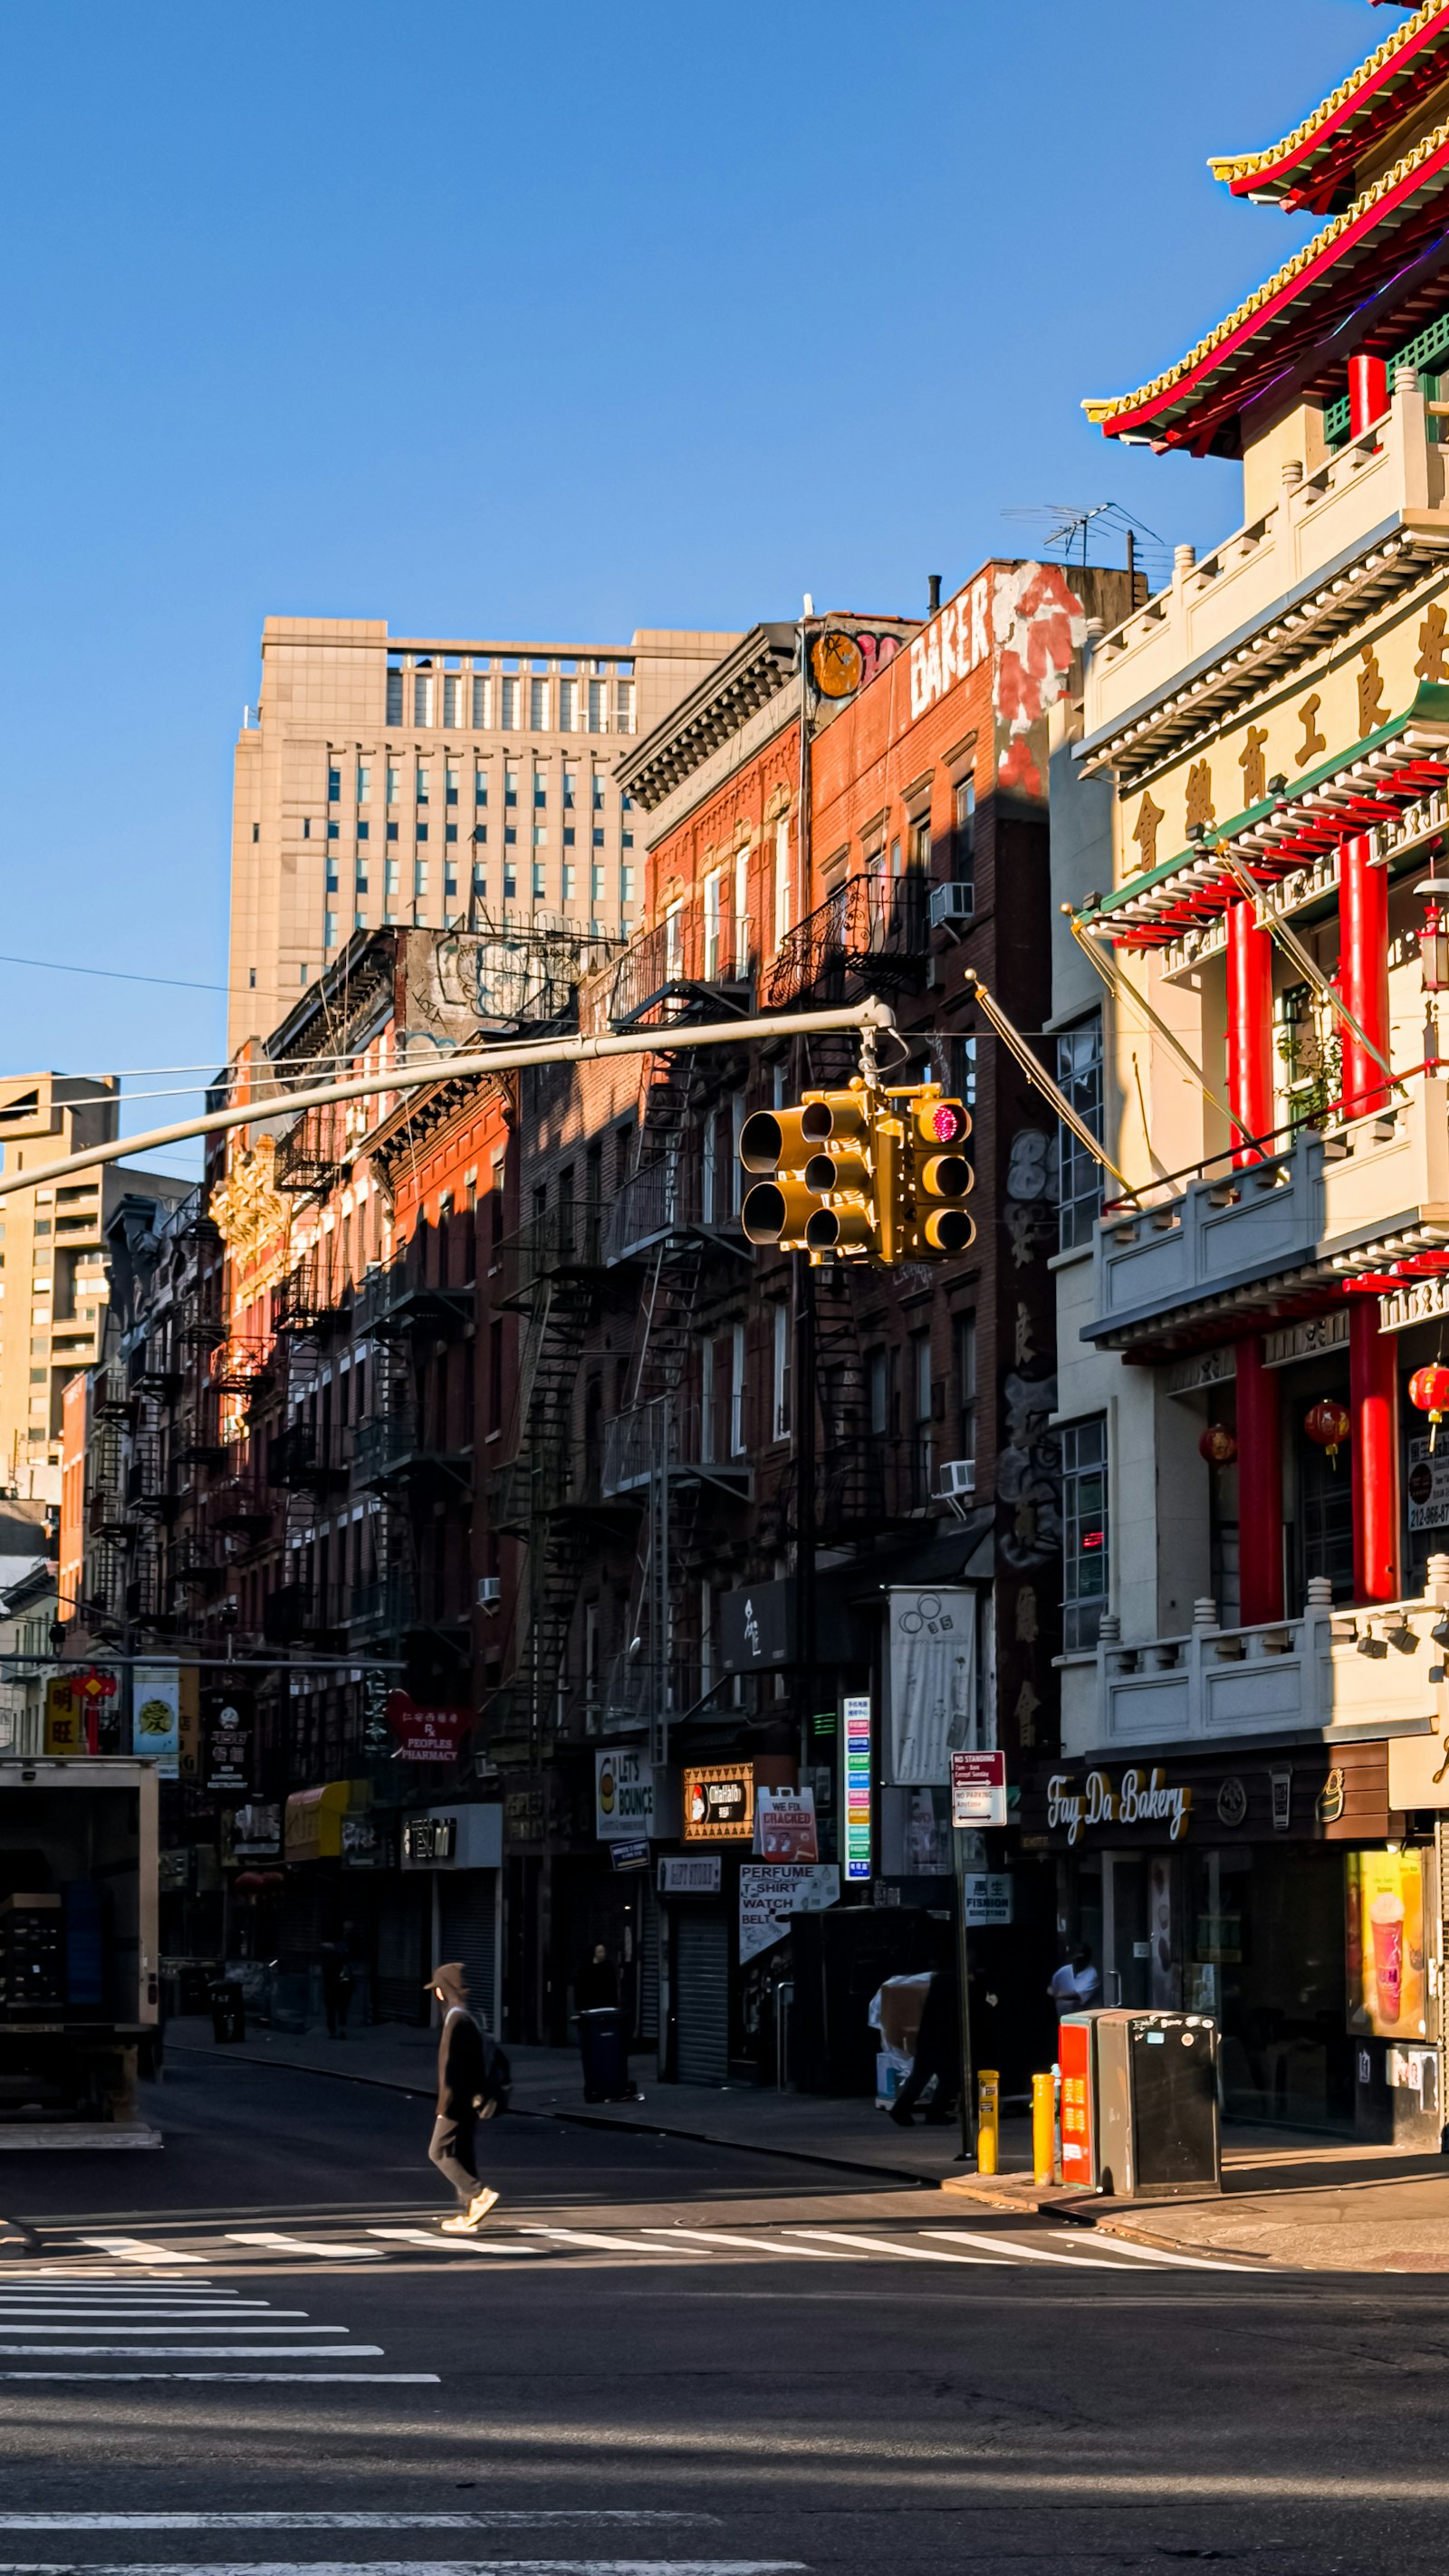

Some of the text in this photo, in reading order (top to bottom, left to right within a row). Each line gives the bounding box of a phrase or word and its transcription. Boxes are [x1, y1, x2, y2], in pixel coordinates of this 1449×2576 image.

[408, 1738, 453, 1748] PEOPLES
[402, 1750, 458, 1761] PHARMACY
[964, 1755, 995, 1763] STANDING
[619, 1786, 653, 1816] BOUNCE
[1047, 1767, 1187, 1845] Fay Da Bakery
[772, 1803, 801, 1811] WE FIX
[763, 1813, 811, 1824] CRACKED
[743, 1867, 815, 1878] PERFUME
[744, 1883, 798, 1893] T-SHIRT
[744, 1899, 793, 1909] WATCH
[743, 1915, 771, 1924] BELT
